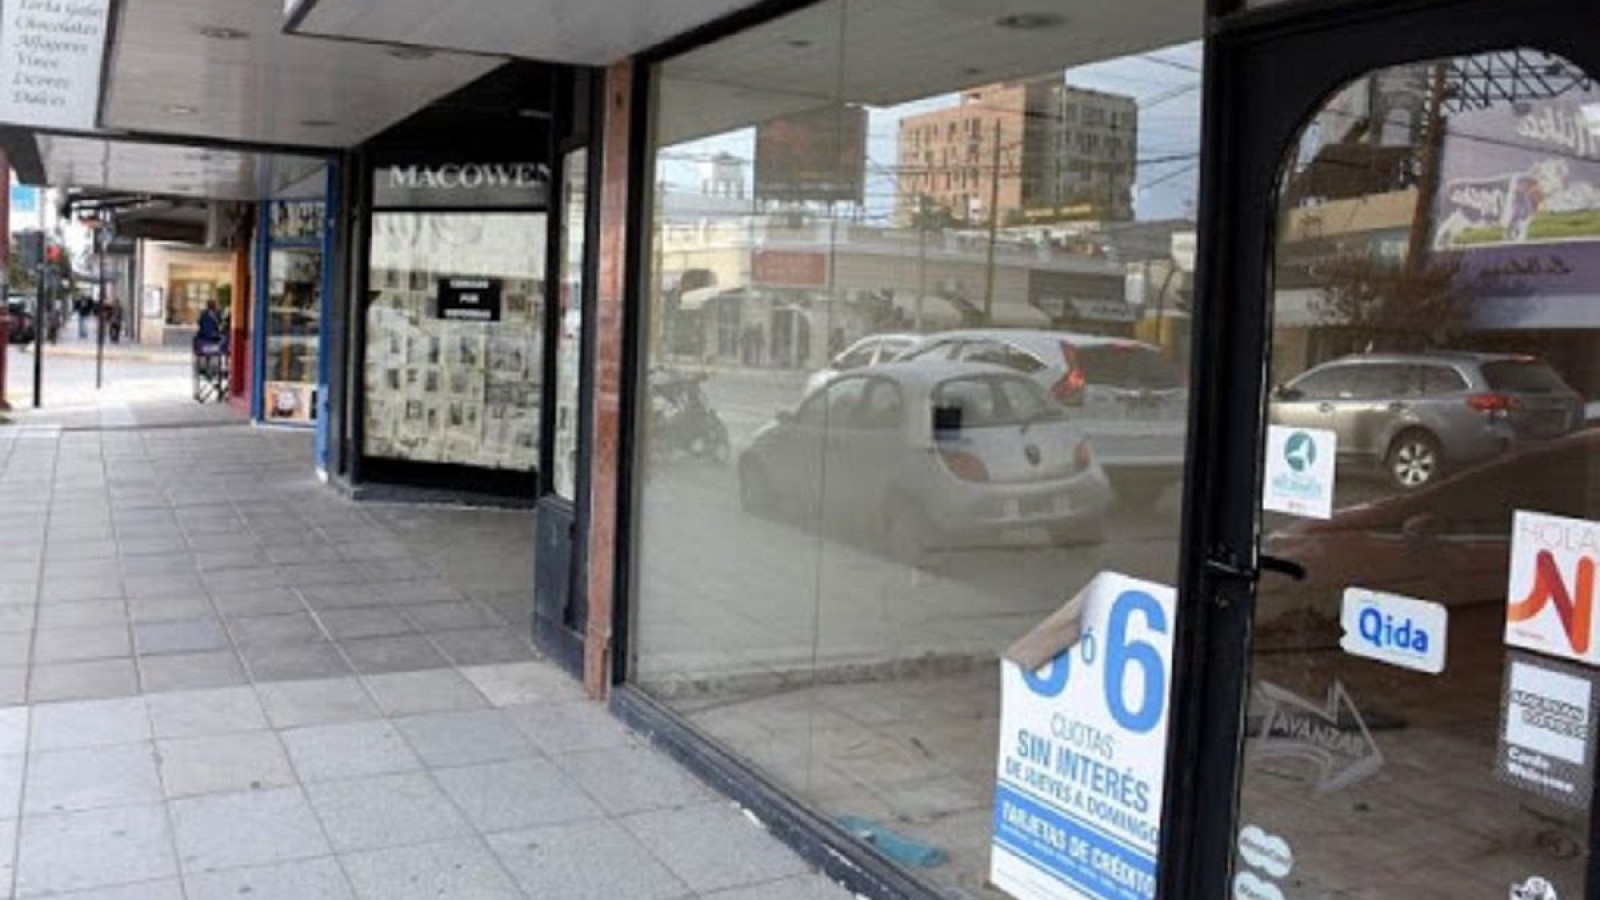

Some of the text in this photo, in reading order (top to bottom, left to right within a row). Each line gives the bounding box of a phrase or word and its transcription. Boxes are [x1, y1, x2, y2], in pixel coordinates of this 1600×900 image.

[1359, 607, 1429, 653] Qida
[1104, 590, 1168, 733] 6
[1051, 712, 1115, 759] CUOTAS
[1006, 756, 1021, 778] DE
[1074, 789, 1085, 810] A
[1017, 728, 1149, 813] SIN INTERÉS
[1069, 834, 1089, 863] DE
